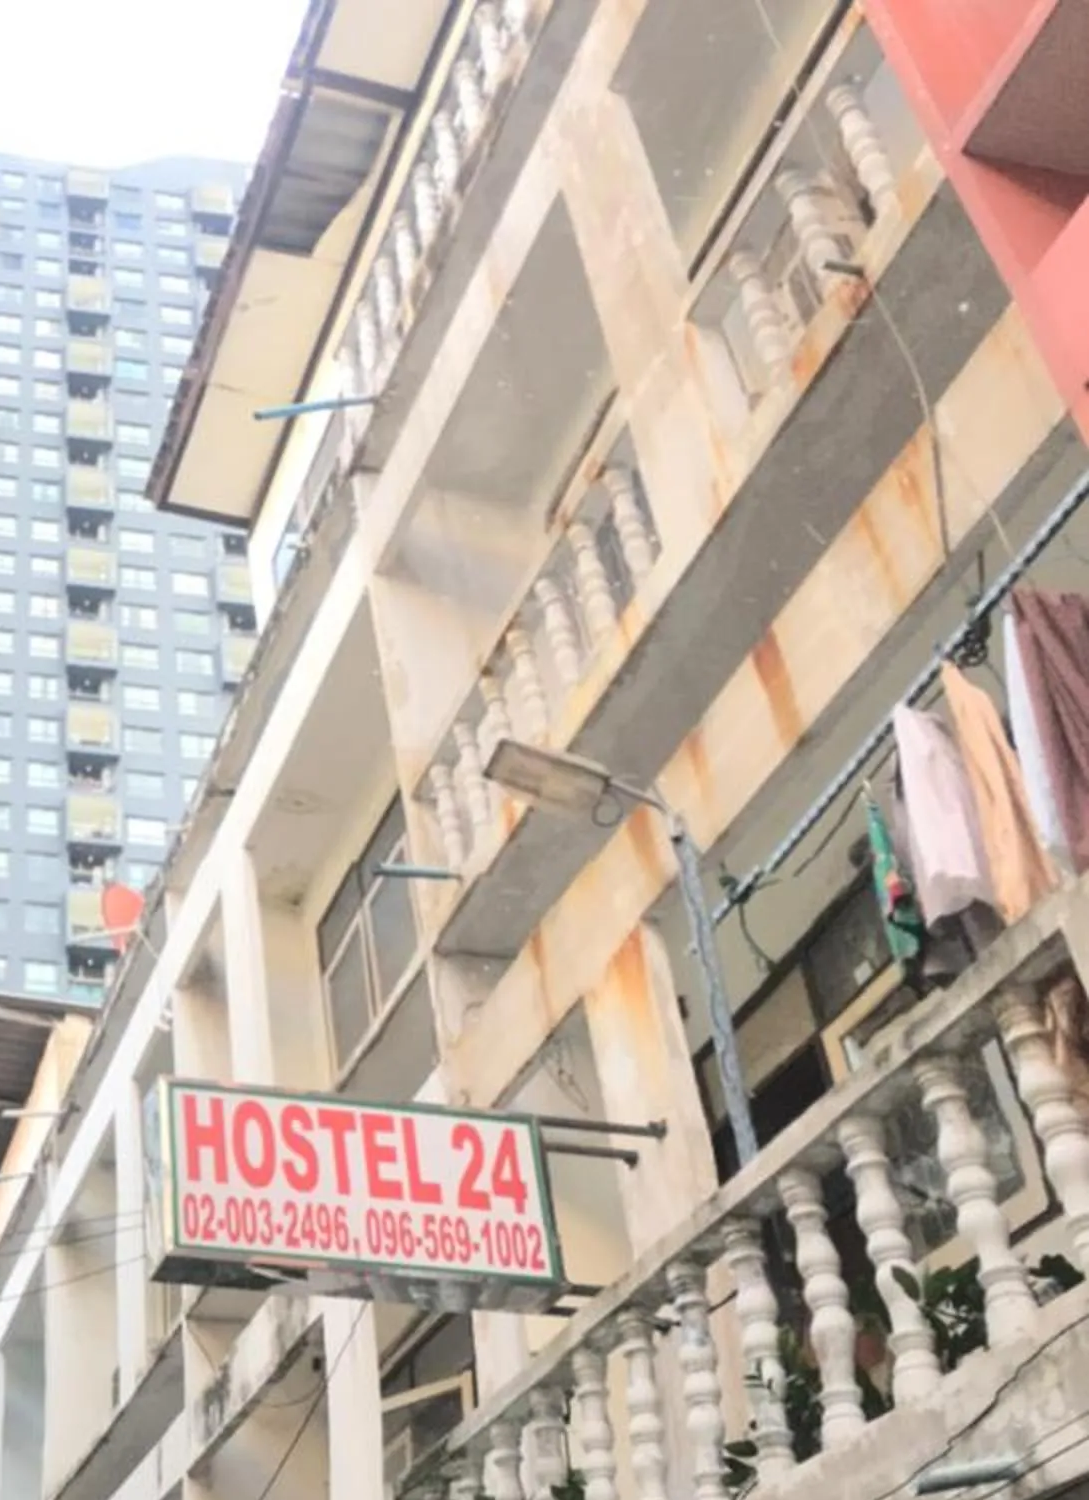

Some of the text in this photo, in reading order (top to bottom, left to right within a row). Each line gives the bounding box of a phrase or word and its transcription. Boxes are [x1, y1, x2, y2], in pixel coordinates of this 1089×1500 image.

[182, 1093, 528, 1215] HOSTEL 24
[365, 1208, 546, 1271] 096-569-1002
